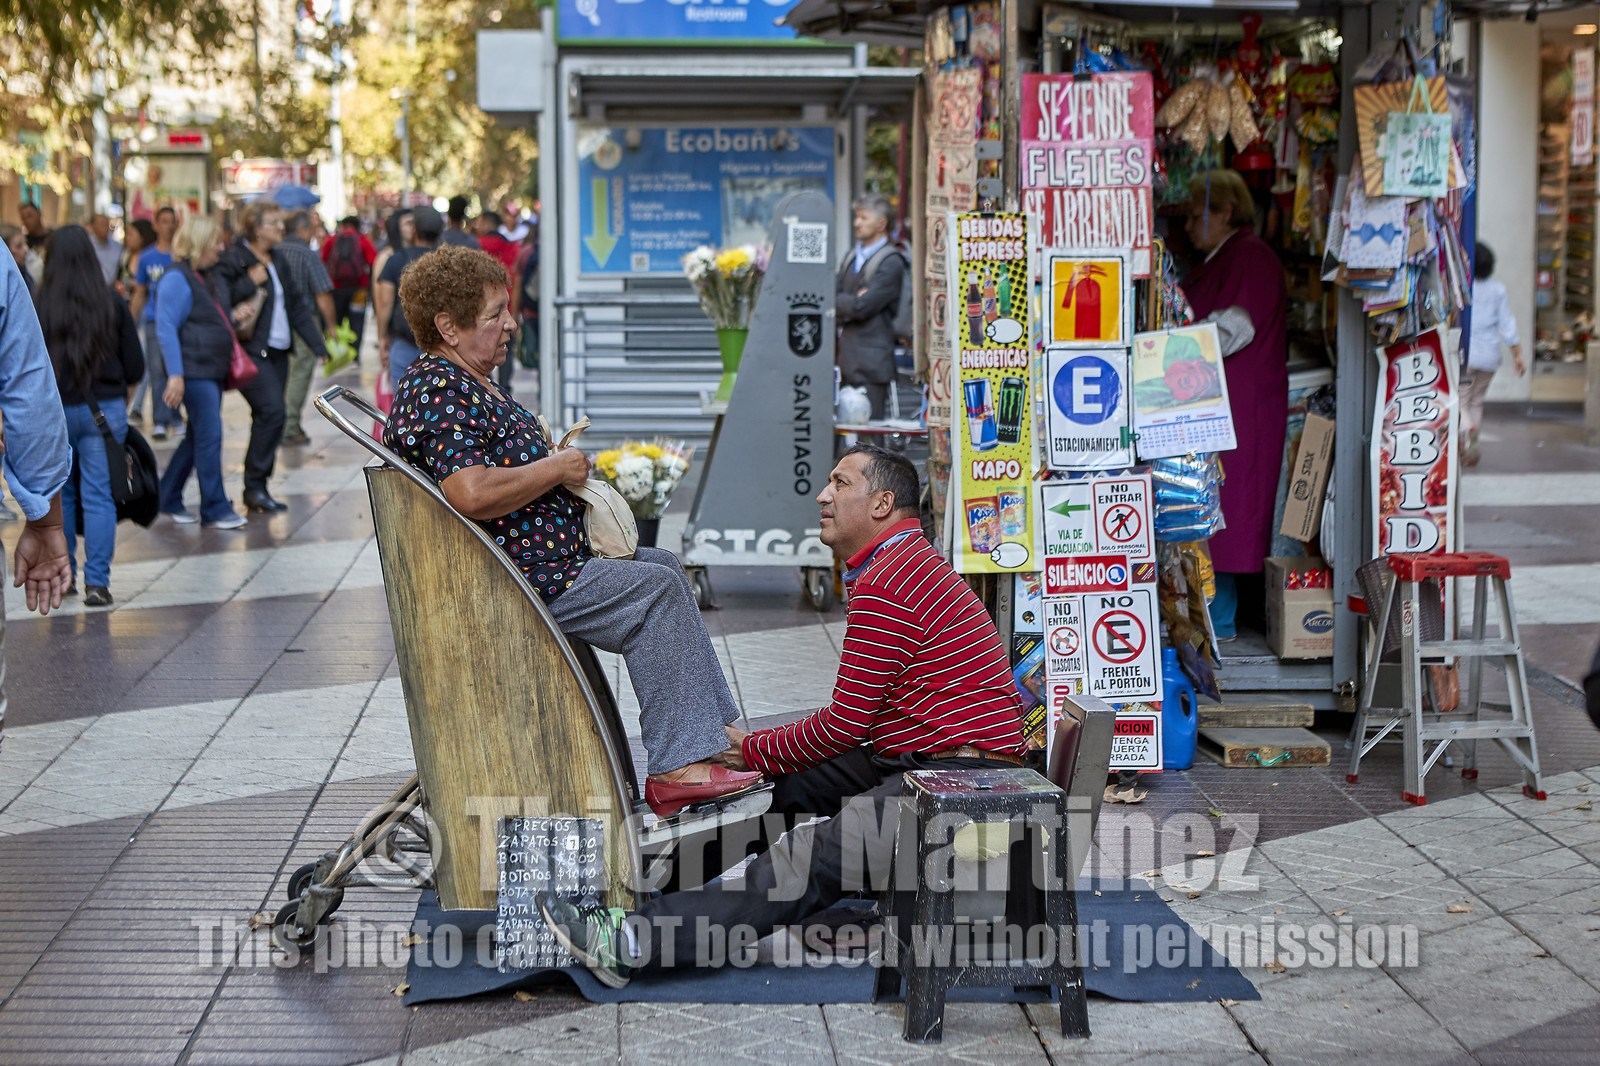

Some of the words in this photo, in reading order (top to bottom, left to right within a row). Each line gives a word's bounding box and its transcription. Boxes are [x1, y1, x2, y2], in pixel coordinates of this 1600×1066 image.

[686, 5, 747, 21] Restroom
[1038, 81, 1062, 142] SE
[1067, 81, 1135, 142] VENDE
[1027, 146, 1146, 188] FLETES
[1052, 188, 1150, 249] ARRIENDA
[960, 218, 1025, 238] BEBIDAS
[961, 240, 1025, 260] EXPRESS
[961, 349, 1028, 369] ENERGETICAS
[1072, 367, 1103, 414] E
[793, 374, 812, 497] SANTIAGO
[972, 459, 1022, 480] KAPO
[1111, 484, 1128, 493] NO
[1098, 493, 1142, 504] ENTRAR
[1058, 529, 1071, 540] VIA
[1073, 528, 1083, 539] DE
[1048, 542, 1094, 555] EVACUACION
[1047, 562, 1106, 587] SILENCIO
[1053, 603, 1071, 616] NO
[1101, 596, 1134, 609] NO
[1048, 616, 1079, 627] ENTRAR
[1051, 657, 1081, 673] MASCOTAS
[1102, 666, 1141, 678] FRENTE
[1094, 680, 1106, 691] AL
[1109, 677, 1151, 690] PORTON
[514, 820, 572, 831] PRECIOS
[498, 834, 558, 849] ZAPATOS
[500, 868, 552, 883] BOTOTOS
[499, 886, 529, 899] BOTA
[499, 903, 529, 917] BOTA
[497, 918, 534, 930] ZAPATO
[498, 944, 526, 957] BOTA
